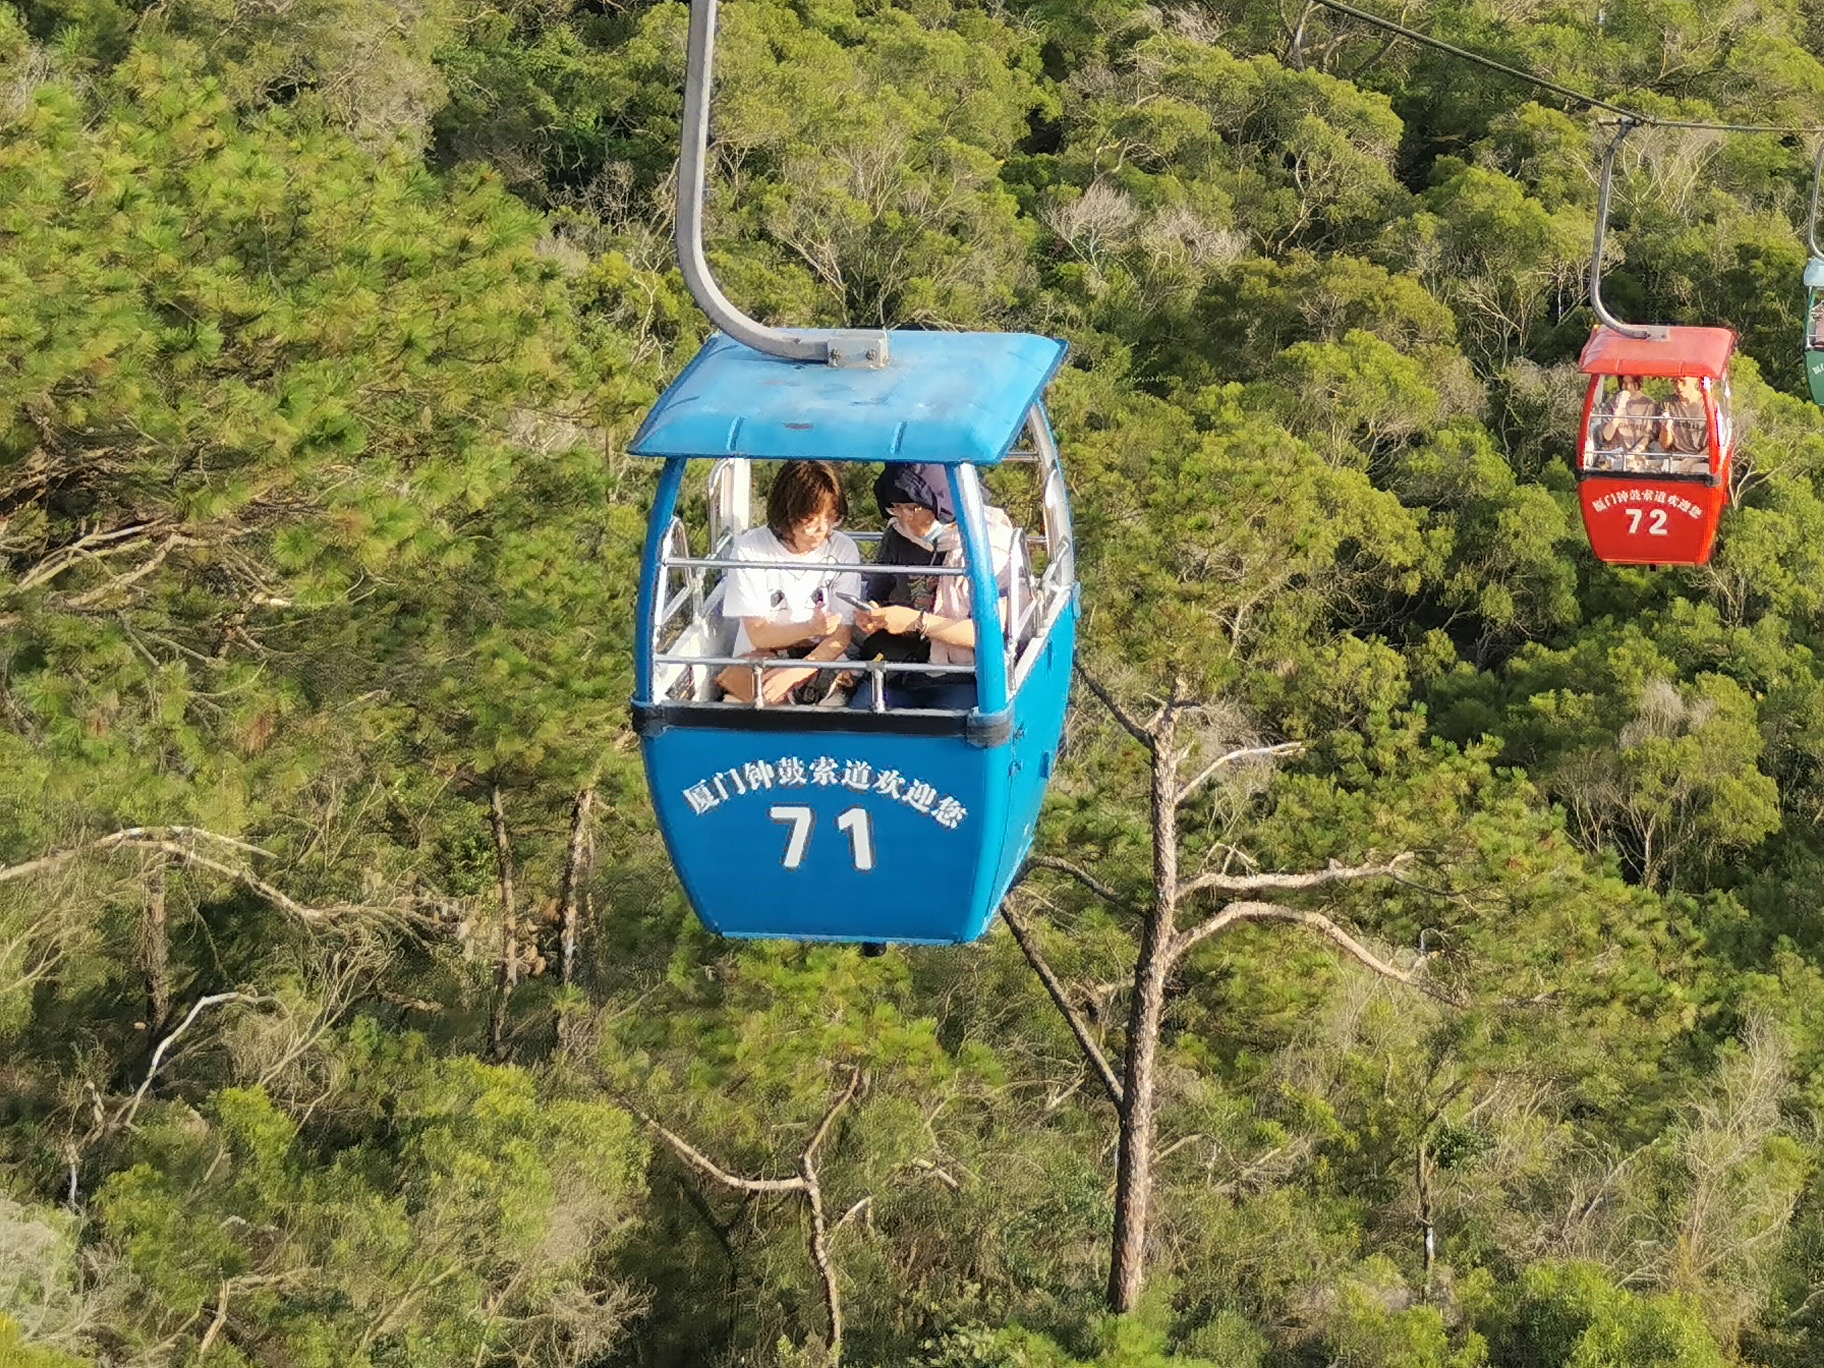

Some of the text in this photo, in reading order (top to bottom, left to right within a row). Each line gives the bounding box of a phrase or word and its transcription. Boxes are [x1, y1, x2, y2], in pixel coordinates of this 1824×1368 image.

[1625, 508, 1668, 536] 72
[681, 755, 969, 830] 厦门钟鼓索道欢迎您
[769, 805, 874, 871] 71
